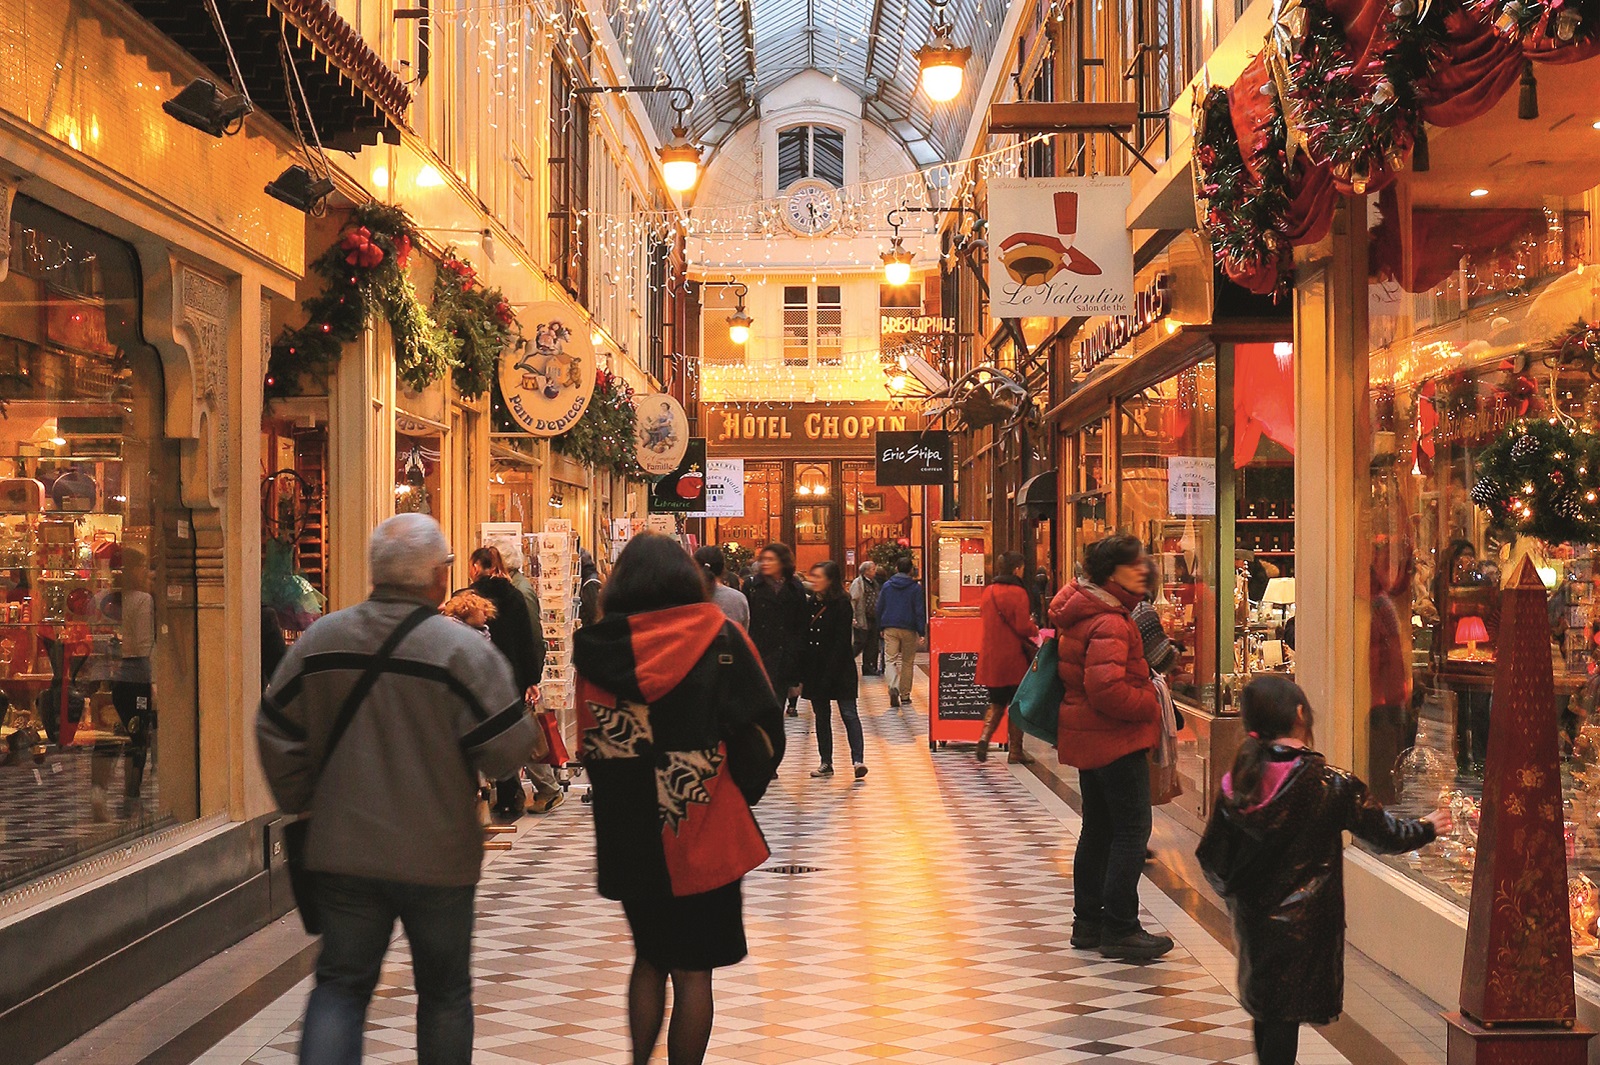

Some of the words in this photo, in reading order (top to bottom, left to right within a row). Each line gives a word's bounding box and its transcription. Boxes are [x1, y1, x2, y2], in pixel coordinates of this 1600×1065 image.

[1000, 281, 1032, 306] Le
[1034, 282, 1126, 306] Valentin
[1076, 304, 1099, 312] Salon
[1113, 303, 1127, 311] thé
[881, 315, 956, 334] BRESILOPHILE
[509, 394, 534, 426] Pain
[719, 410, 791, 440] HÔTEL
[804, 412, 906, 440] CHOPIN
[882, 447, 906, 462] Eric
[904, 444, 943, 467] Stipa
[645, 462, 674, 470] Famille
[654, 498, 691, 508] Librairie
[722, 523, 767, 540] HOTEL
[861, 523, 907, 539] HOTEL
